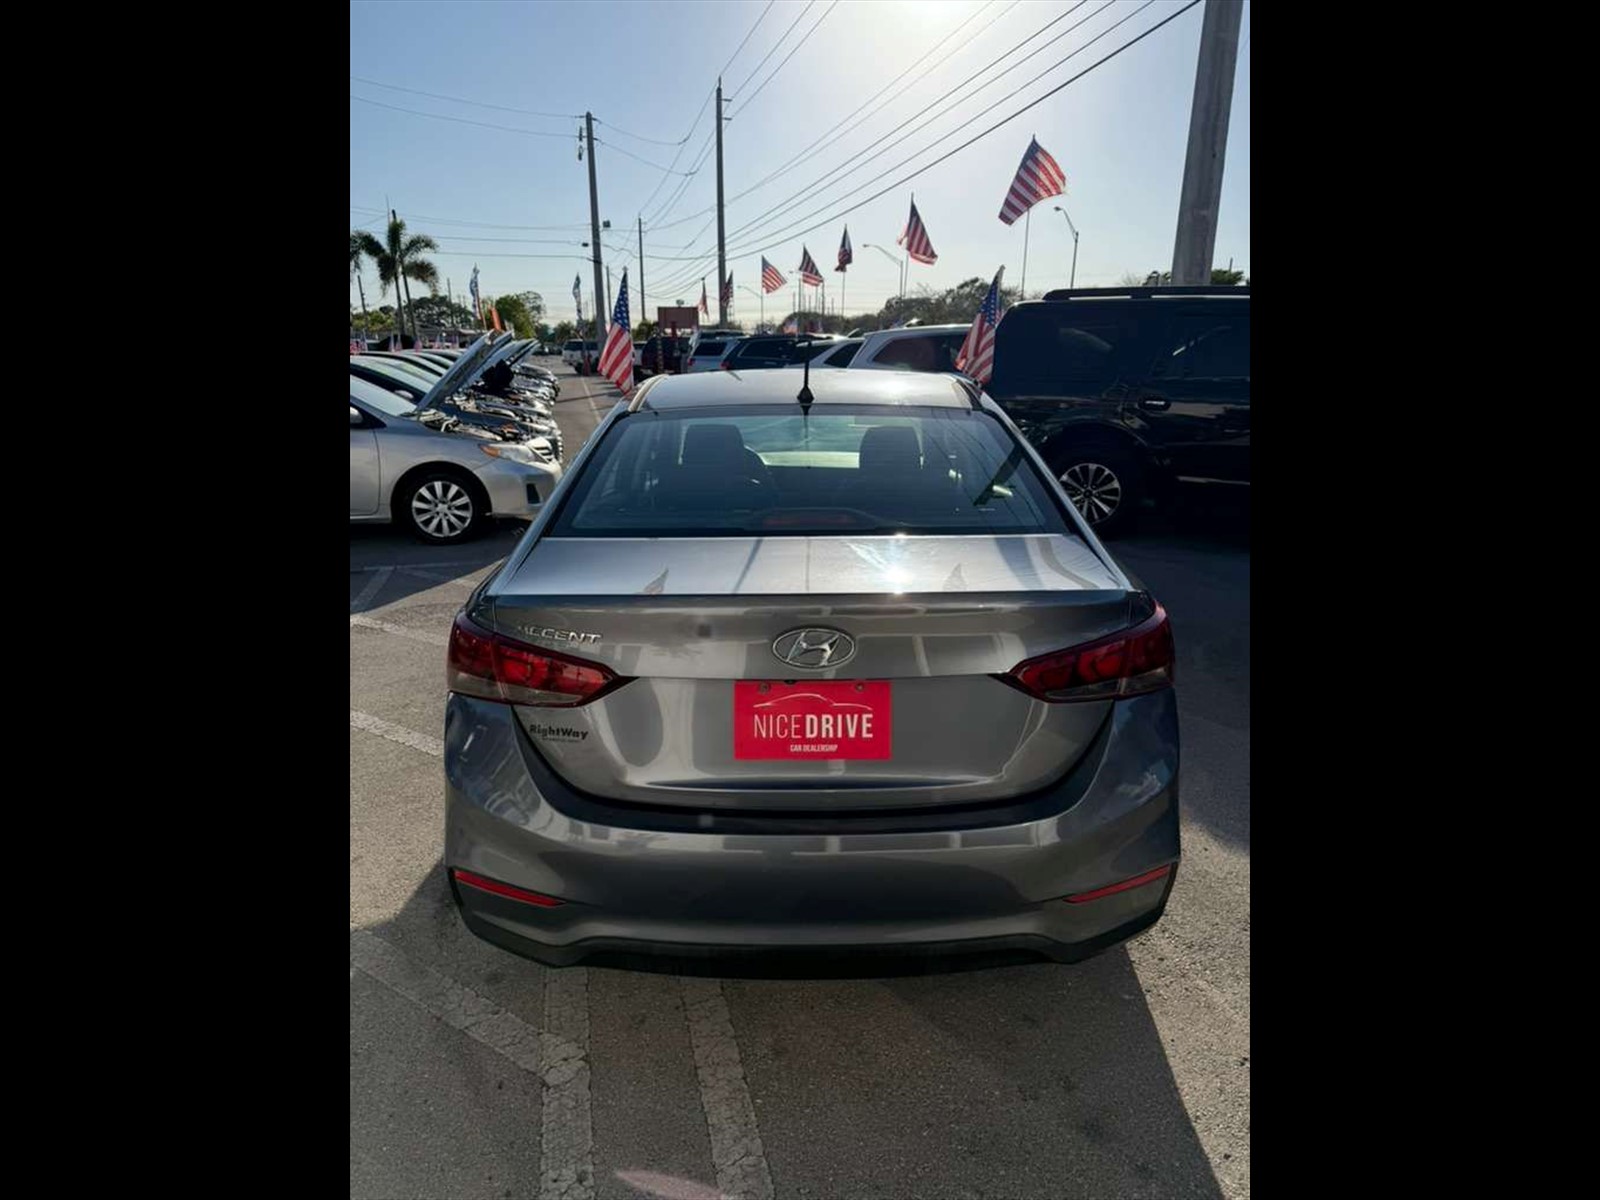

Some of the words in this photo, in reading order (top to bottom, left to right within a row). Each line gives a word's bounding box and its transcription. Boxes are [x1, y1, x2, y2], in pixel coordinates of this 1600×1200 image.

[529, 724, 589, 741] RightWay
[789, 744, 802, 753] CAR
[802, 744, 839, 753] DEALERSHIP
